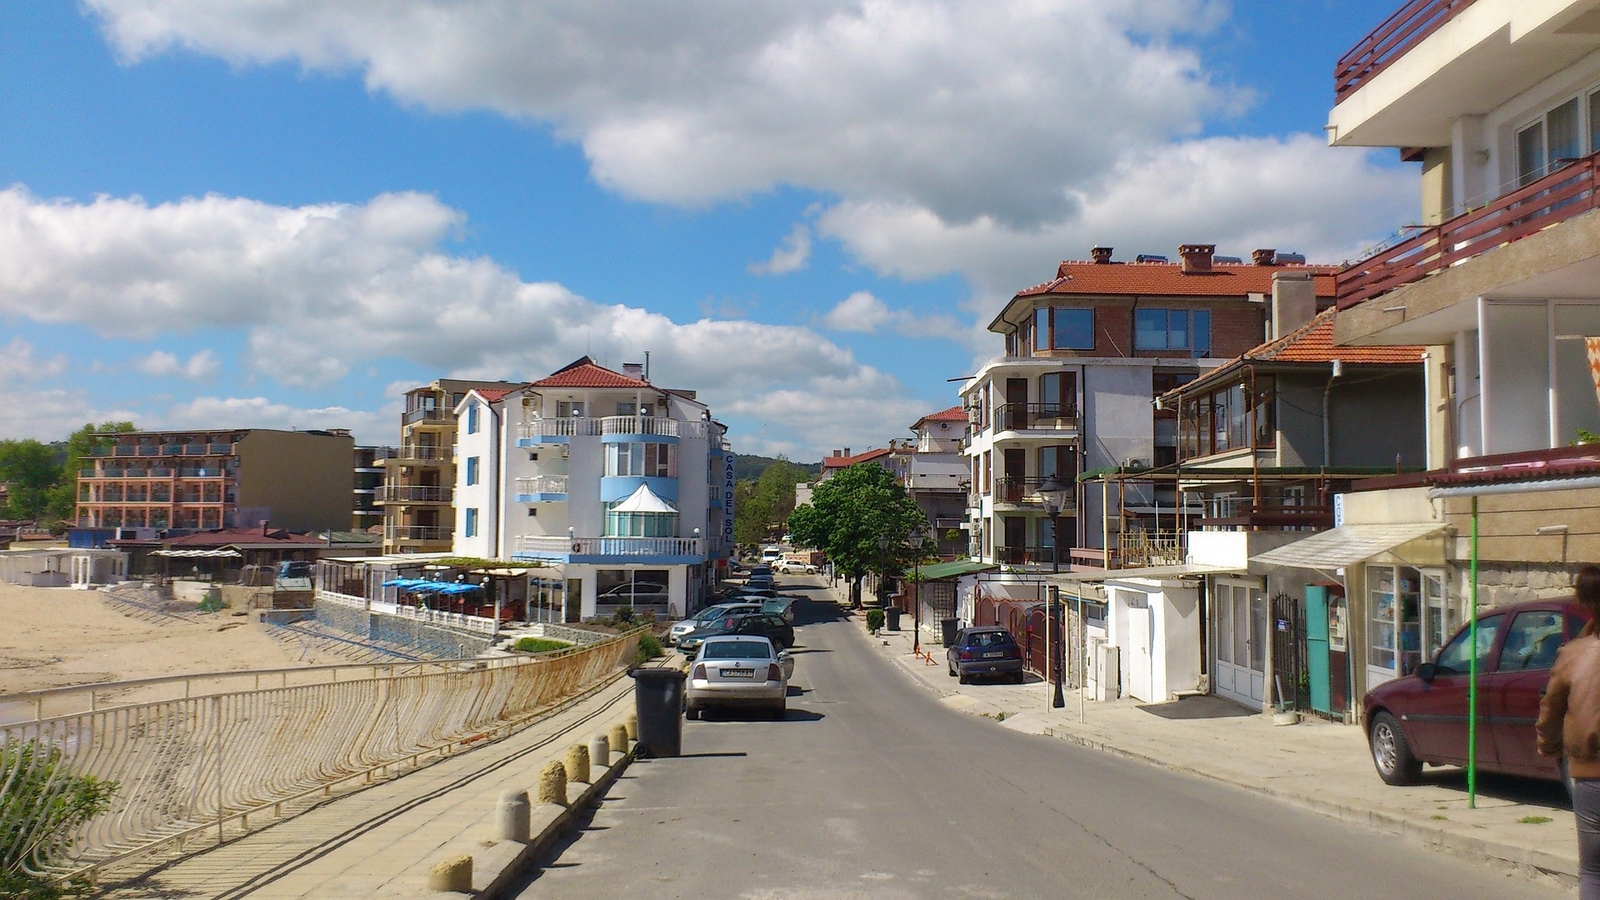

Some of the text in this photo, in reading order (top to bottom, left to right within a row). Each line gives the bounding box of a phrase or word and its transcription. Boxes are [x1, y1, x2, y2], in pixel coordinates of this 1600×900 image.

[724, 455, 733, 543] CASA DEL SOL
